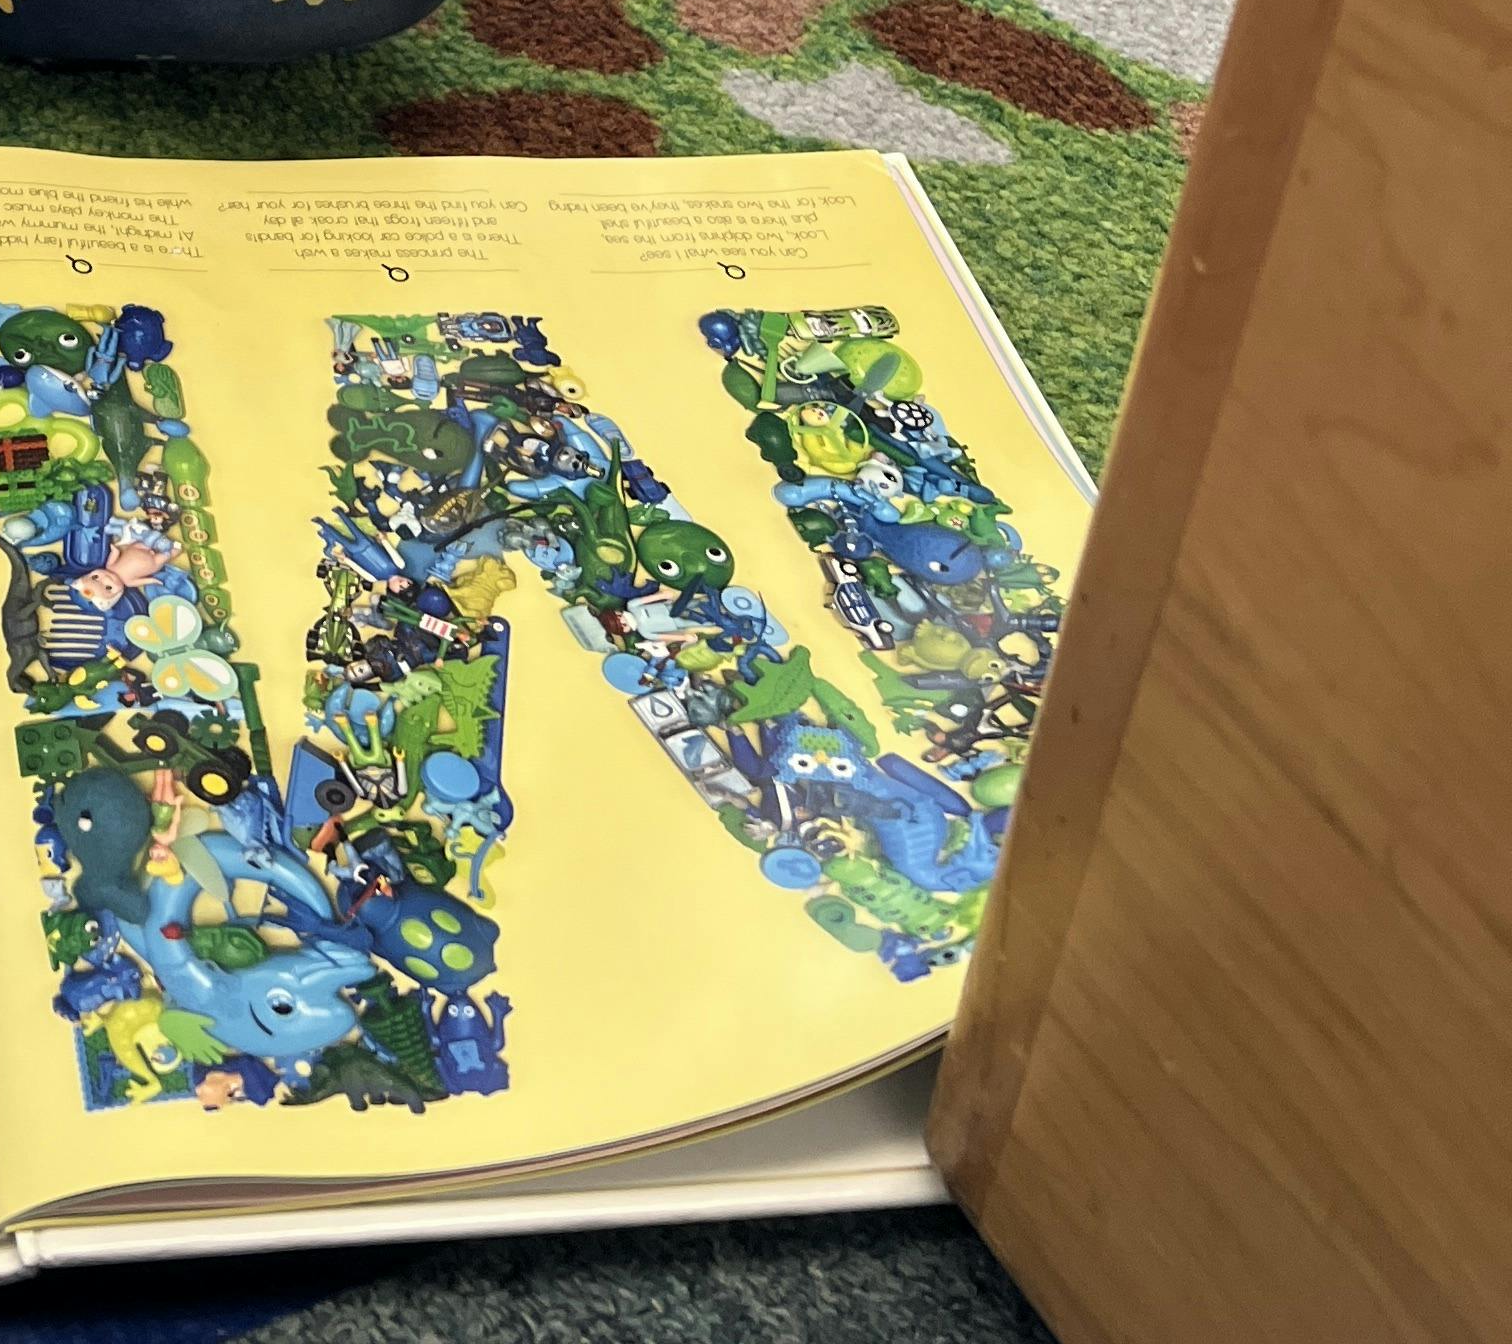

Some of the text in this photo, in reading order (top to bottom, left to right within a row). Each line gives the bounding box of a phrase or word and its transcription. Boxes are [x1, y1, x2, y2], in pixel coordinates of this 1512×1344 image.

[29, 188, 58, 201] blue
[63, 190, 84, 202] the
[90, 193, 129, 207] friend
[5, 203, 44, 214] music
[135, 197, 151, 209] his
[157, 198, 192, 209] while
[49, 204, 82, 217] plays
[88, 207, 143, 222] monkey
[22, 218, 78, 232] mummy
[149, 214, 178, 225] The
[84, 224, 106, 235] the
[112, 225, 172, 241] midnight,
[179, 230, 194, 241] At
[34, 235, 62, 248] fairy
[68, 239, 125, 253] beautiful
[130, 243, 138, 252] a
[144, 244, 153, 253] is
[295, 246, 488, 261] The princess makes a wish
